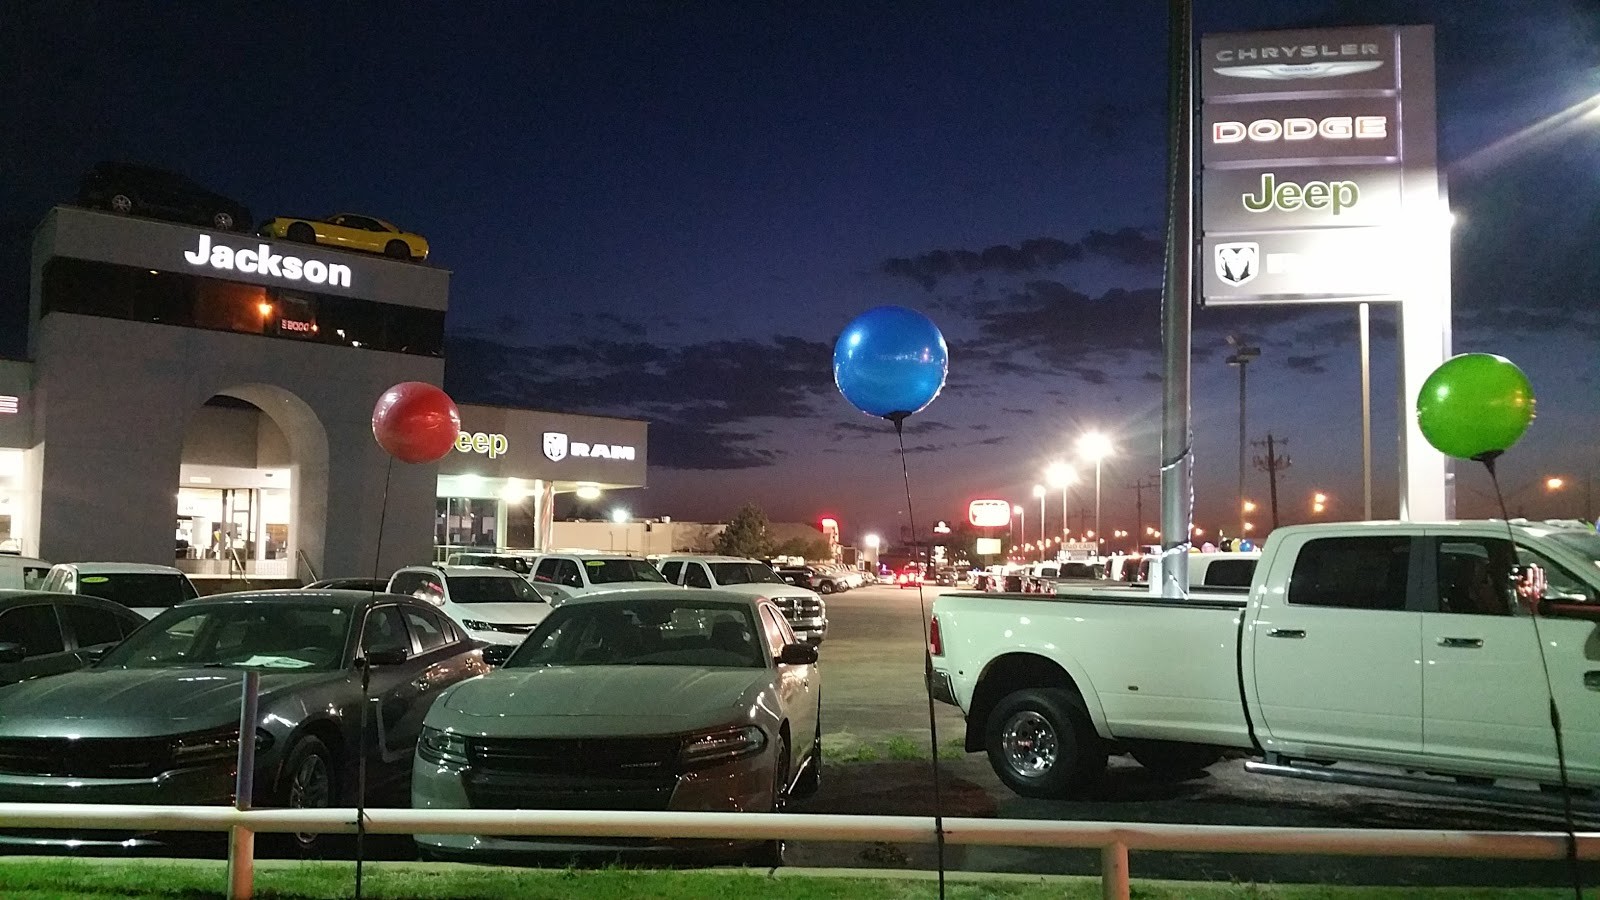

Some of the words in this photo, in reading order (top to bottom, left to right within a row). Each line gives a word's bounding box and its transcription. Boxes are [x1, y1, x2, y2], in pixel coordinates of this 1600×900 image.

[1216, 43, 1379, 62] CHRYSLER
[1213, 116, 1387, 143] DODGE
[1243, 173, 1360, 215] Jeep
[184, 234, 351, 287] Jackson
[455, 431, 508, 459] eep
[570, 442, 635, 460] RAM
